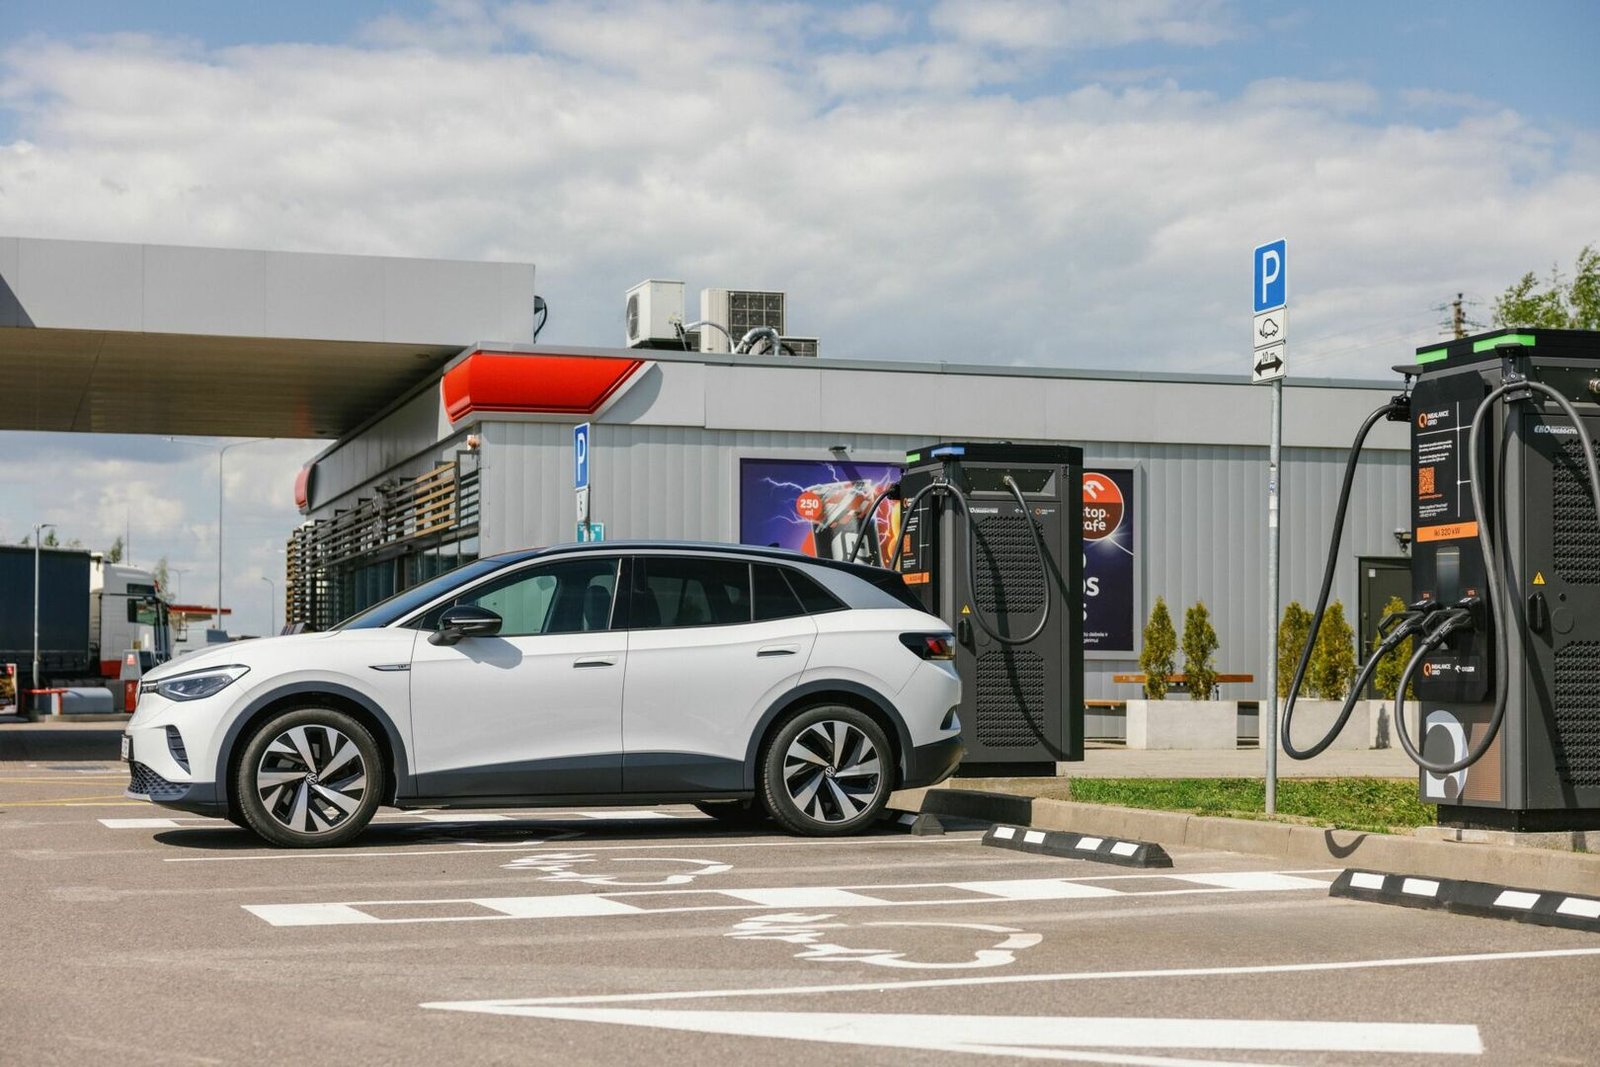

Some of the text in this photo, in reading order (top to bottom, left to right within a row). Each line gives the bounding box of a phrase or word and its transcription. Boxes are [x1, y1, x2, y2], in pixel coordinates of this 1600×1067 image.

[1263, 250, 1280, 303] P
[1262, 351, 1269, 363] 10
[577, 433, 586, 481] P
[800, 499, 819, 509] 250
[805, 509, 814, 517] ml
[1082, 506, 1110, 521] top.
[1082, 520, 1107, 532] afe
